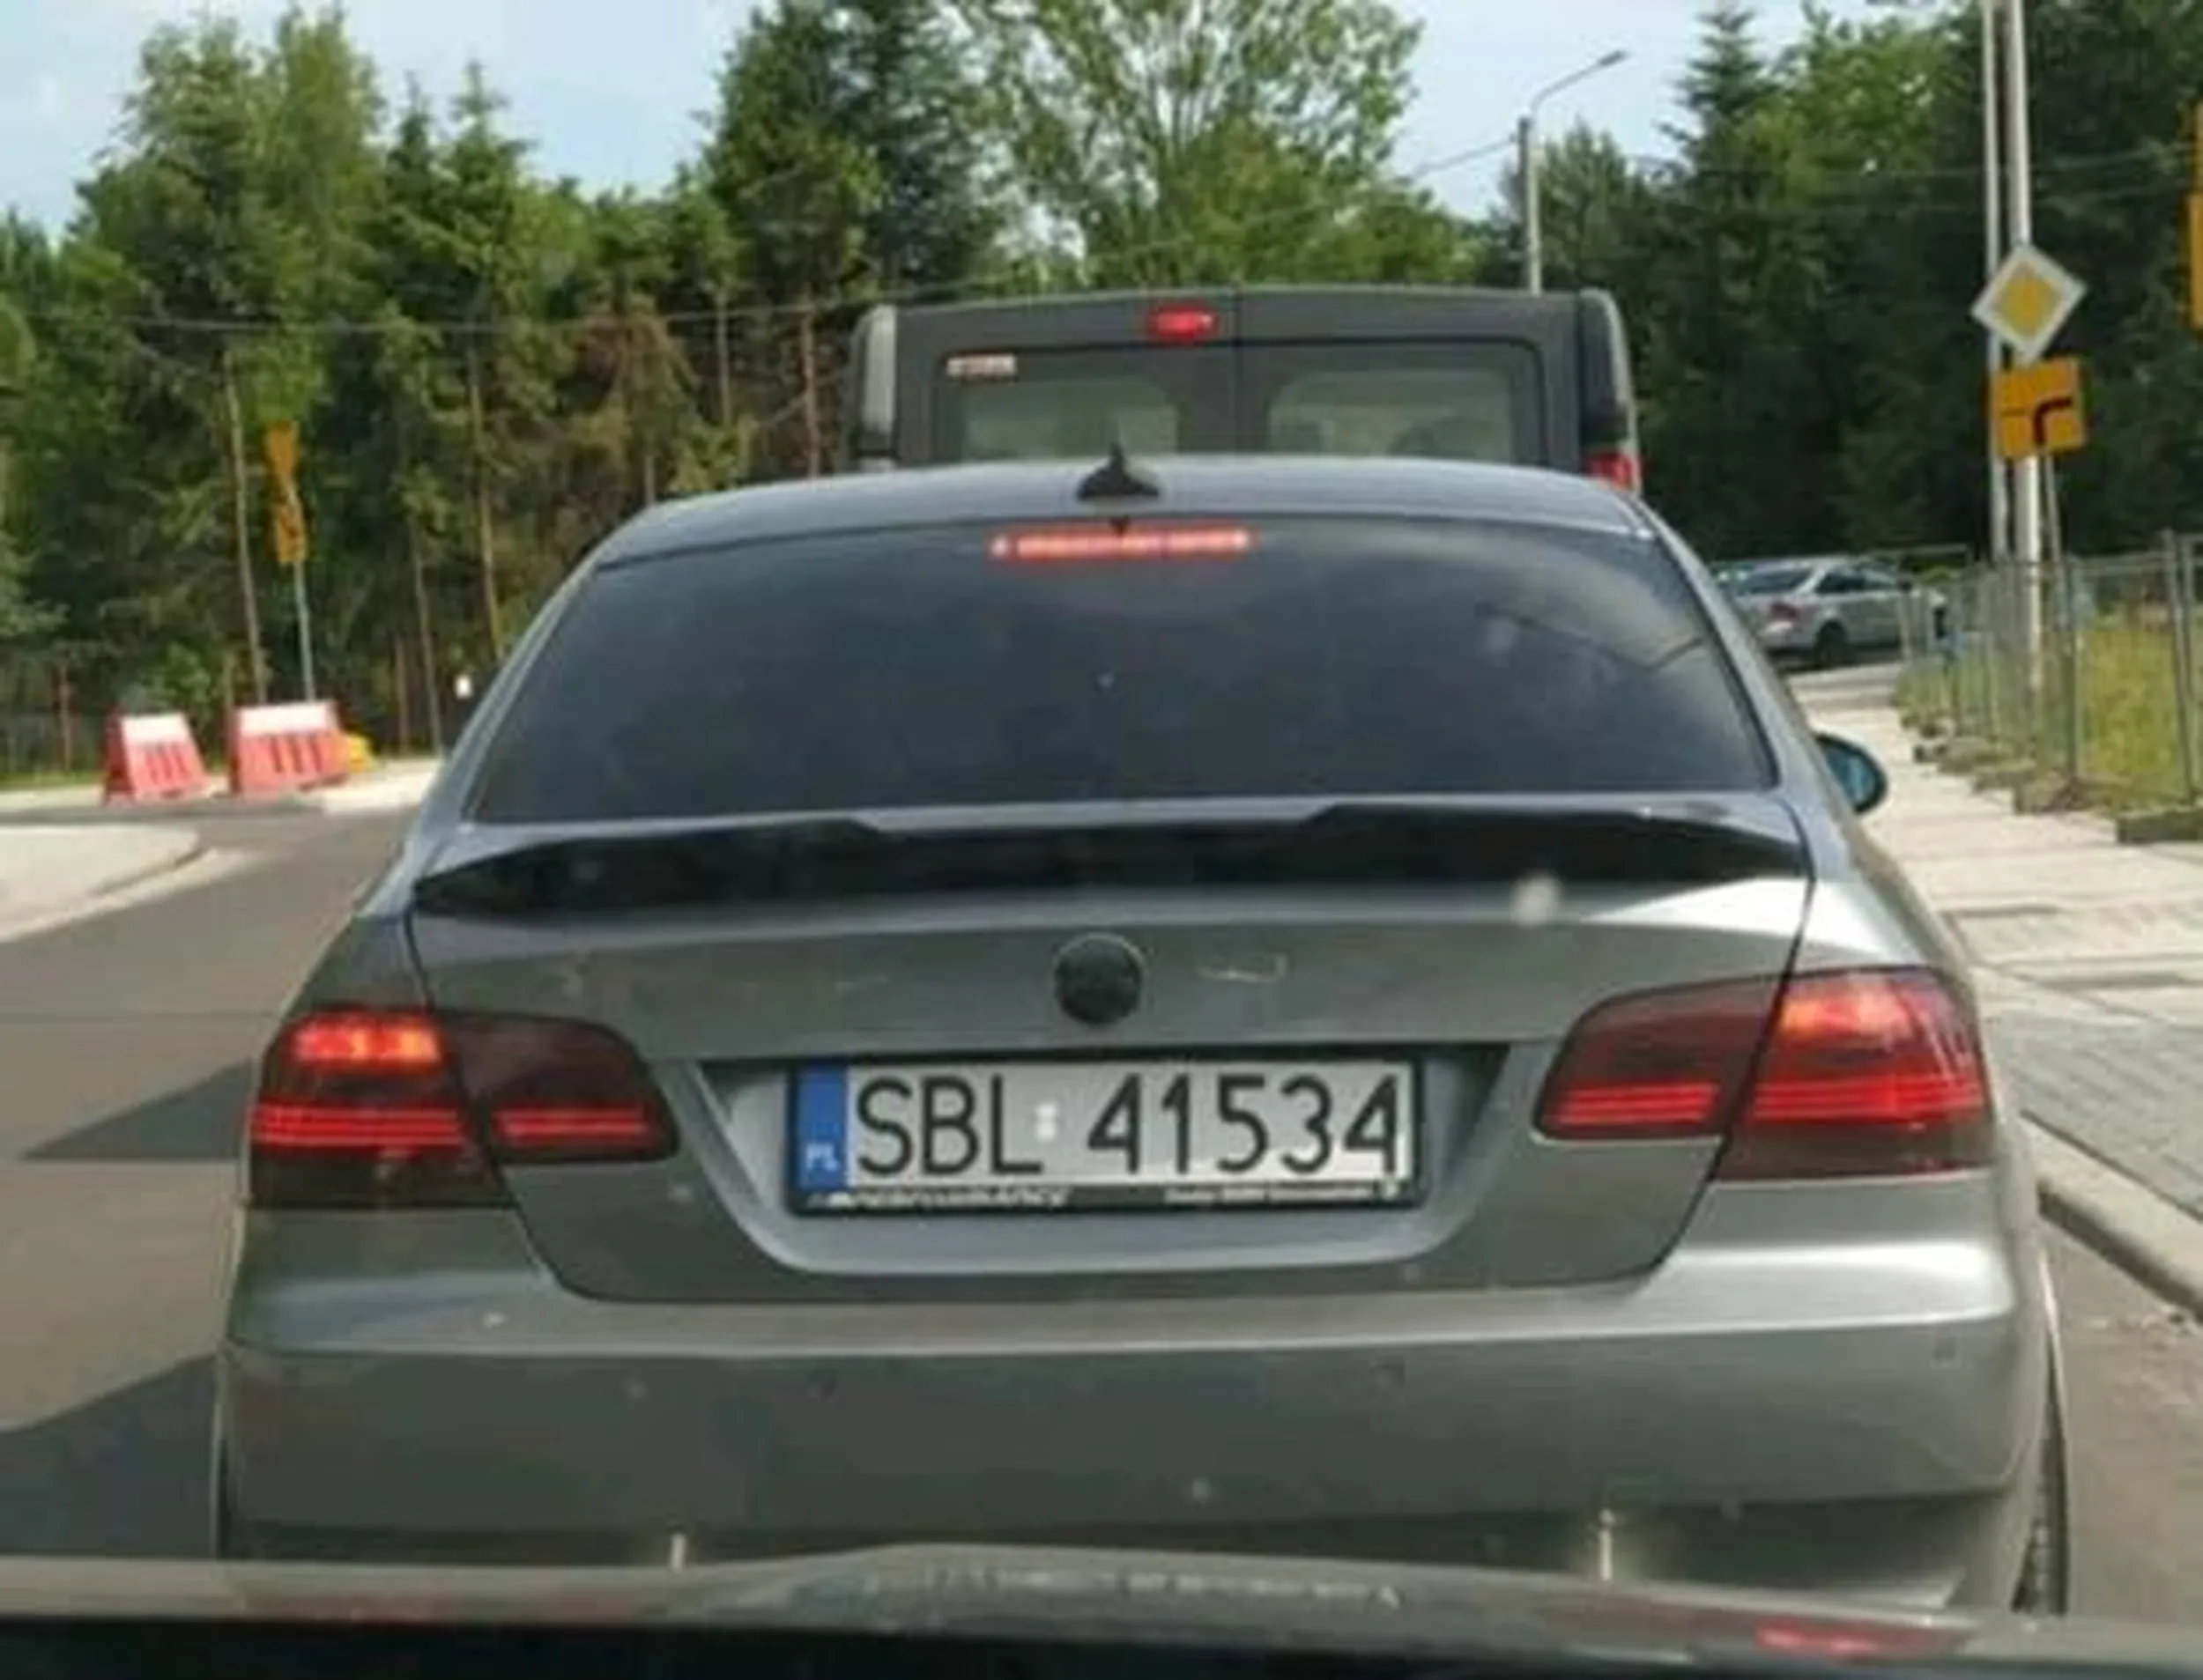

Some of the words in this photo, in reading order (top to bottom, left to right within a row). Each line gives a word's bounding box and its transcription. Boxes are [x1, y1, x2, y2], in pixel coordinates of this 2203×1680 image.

[857, 1072, 1043, 1176] SBL
[1087, 1072, 1399, 1176] 41534
[805, 1143, 841, 1173] PL
